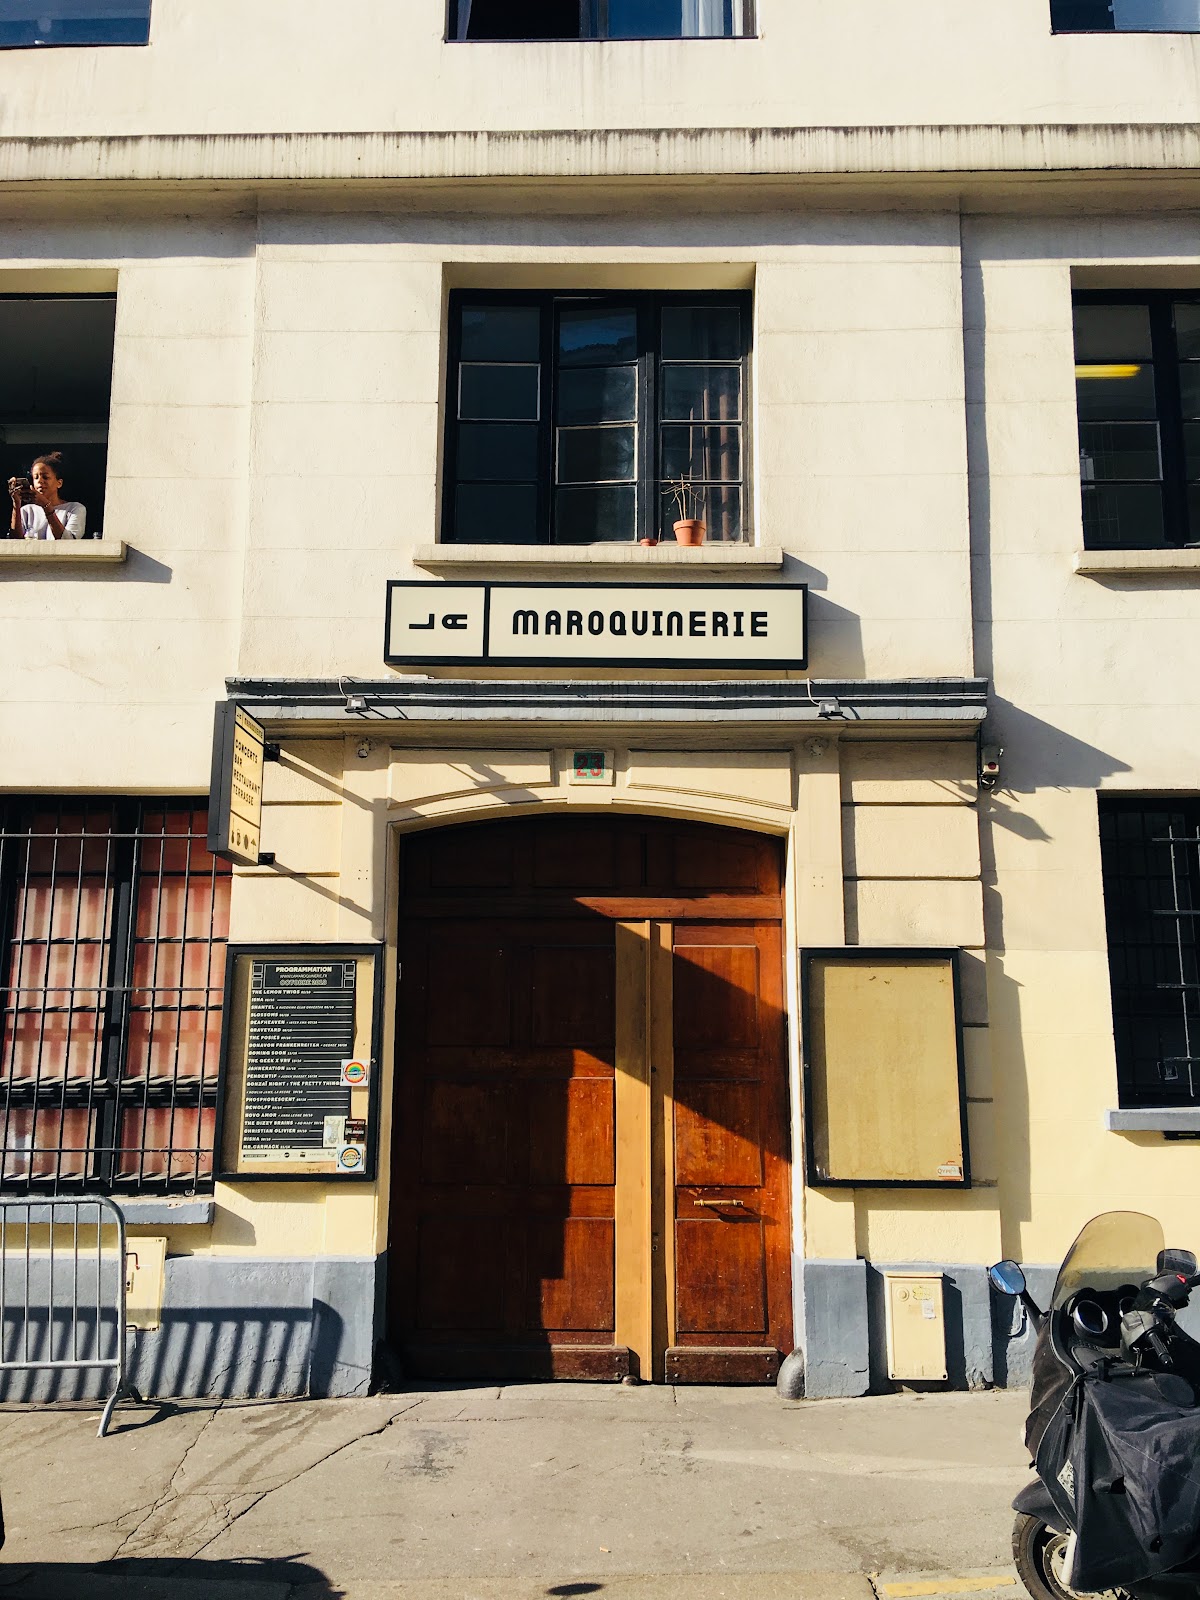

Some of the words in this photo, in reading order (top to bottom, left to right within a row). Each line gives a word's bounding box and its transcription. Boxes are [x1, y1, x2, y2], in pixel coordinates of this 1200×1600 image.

[409, 613, 467, 630] LA
[513, 609, 768, 637] MAROQUINERIE
[234, 753, 243, 768] BAR
[235, 739, 258, 764] CONCERTS
[576, 754, 602, 777] 23
[233, 769, 260, 796] RESTAURANT
[232, 784, 254, 806] TERRASSE
